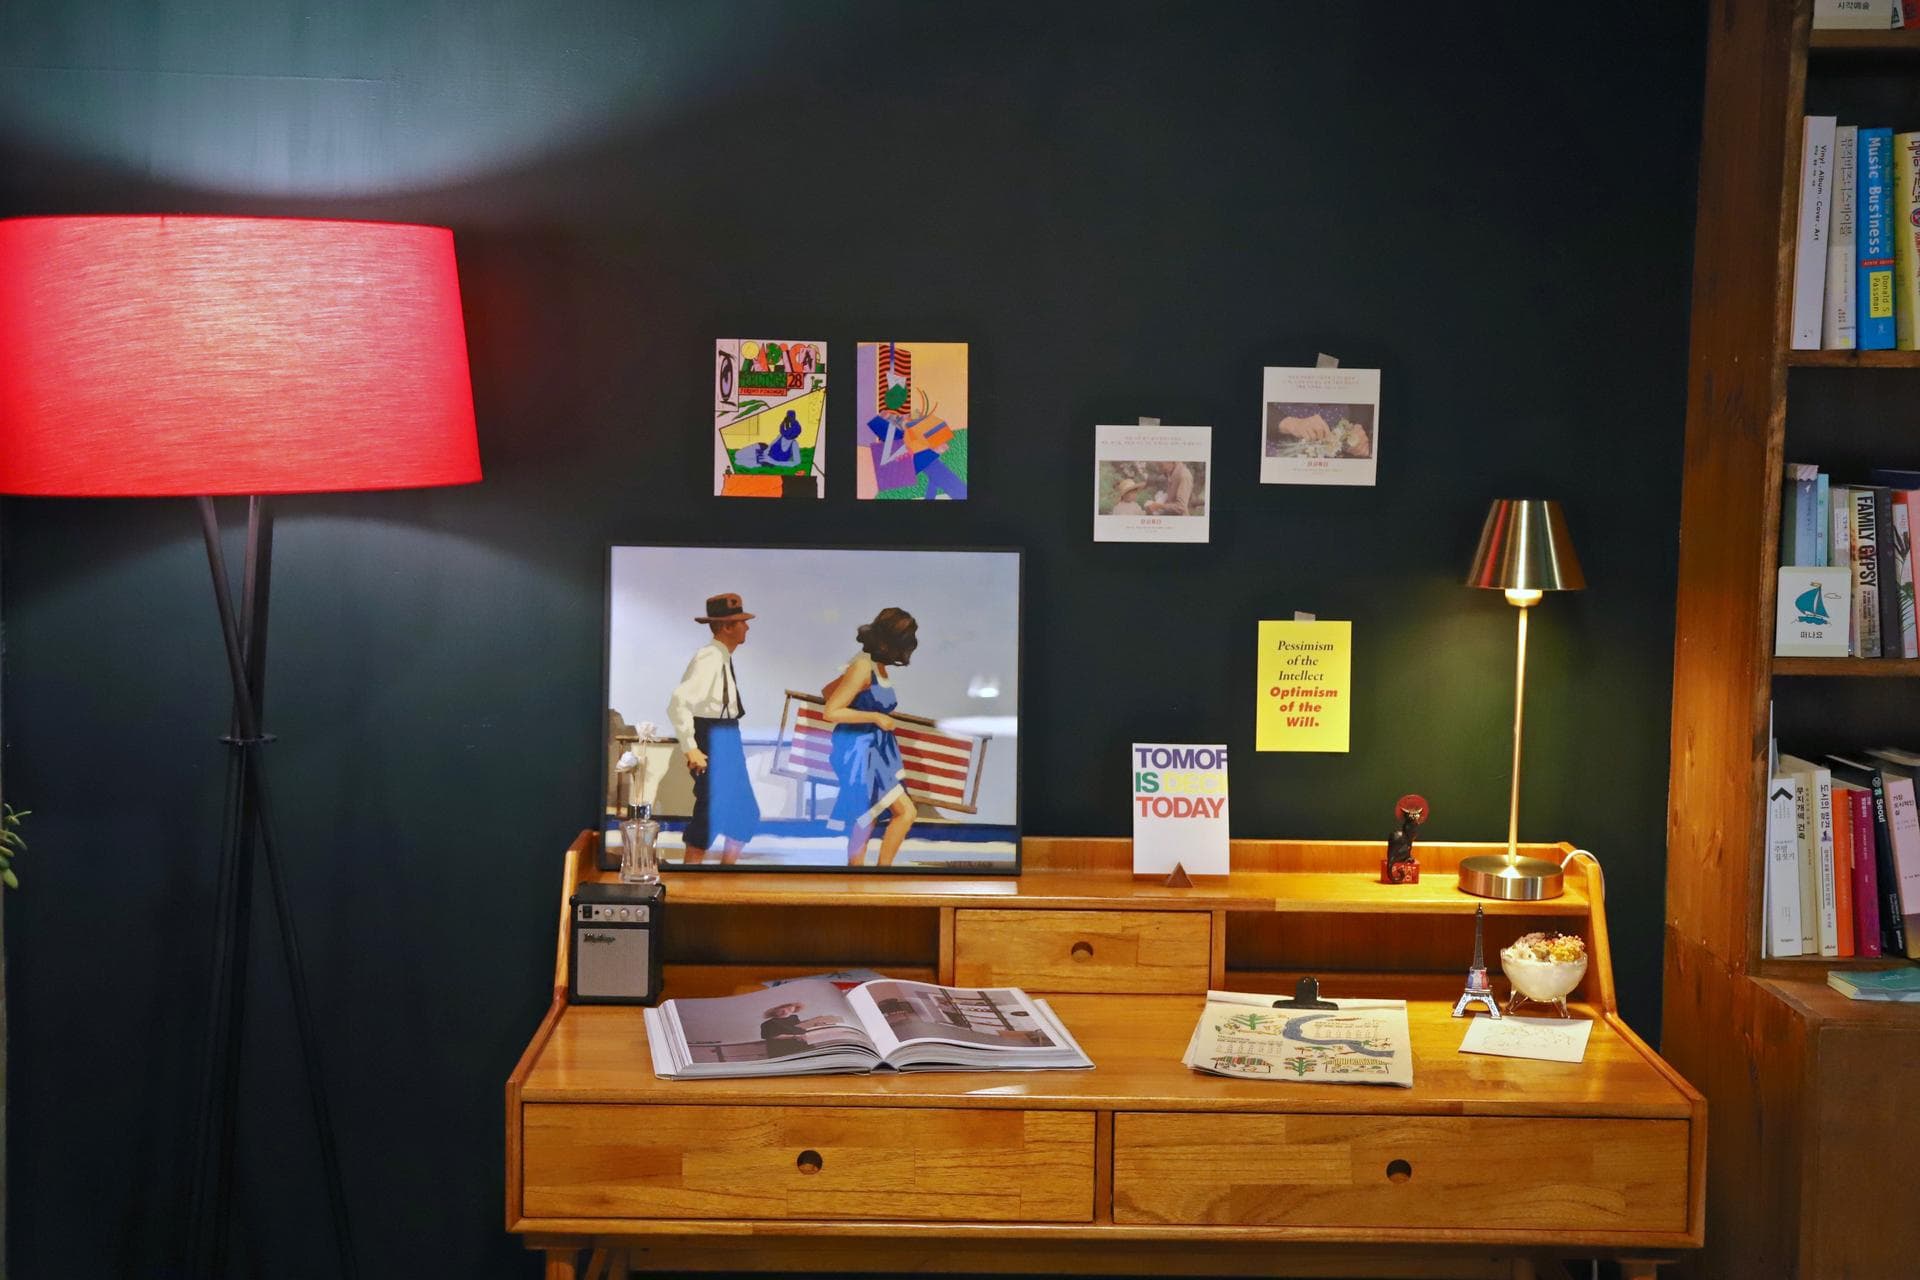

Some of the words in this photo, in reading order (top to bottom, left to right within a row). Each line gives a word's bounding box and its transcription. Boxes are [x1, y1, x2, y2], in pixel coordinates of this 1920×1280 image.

[1818, 145, 1827, 165] Vinyl
[1869, 138, 1882, 179] Music
[1817, 170, 1825, 195] Album
[1814, 200, 1823, 222] Cover
[1869, 186, 1882, 255] Business
[1813, 228, 1821, 241] Art
[1881, 275, 1889, 299] Donald
[787, 373, 803, 388] 28
[1857, 496, 1874, 541] FAMILY
[1859, 545, 1876, 587] GYPSY
[1278, 640, 1334, 651] Pessimism
[1800, 631, 1823, 639] 떠나요
[1287, 654, 1301, 666] of
[1301, 655, 1319, 666] the
[1278, 670, 1323, 681] Intellect
[1270, 686, 1338, 700] Optimism
[1279, 701, 1295, 712] of
[1299, 702, 1322, 712] the
[1287, 717, 1320, 728] Will.
[1135, 772, 1160, 793] IS
[1820, 784, 1830, 809] 도시의
[1135, 797, 1226, 818] TODAY
[1876, 798, 1886, 823] Seoul
